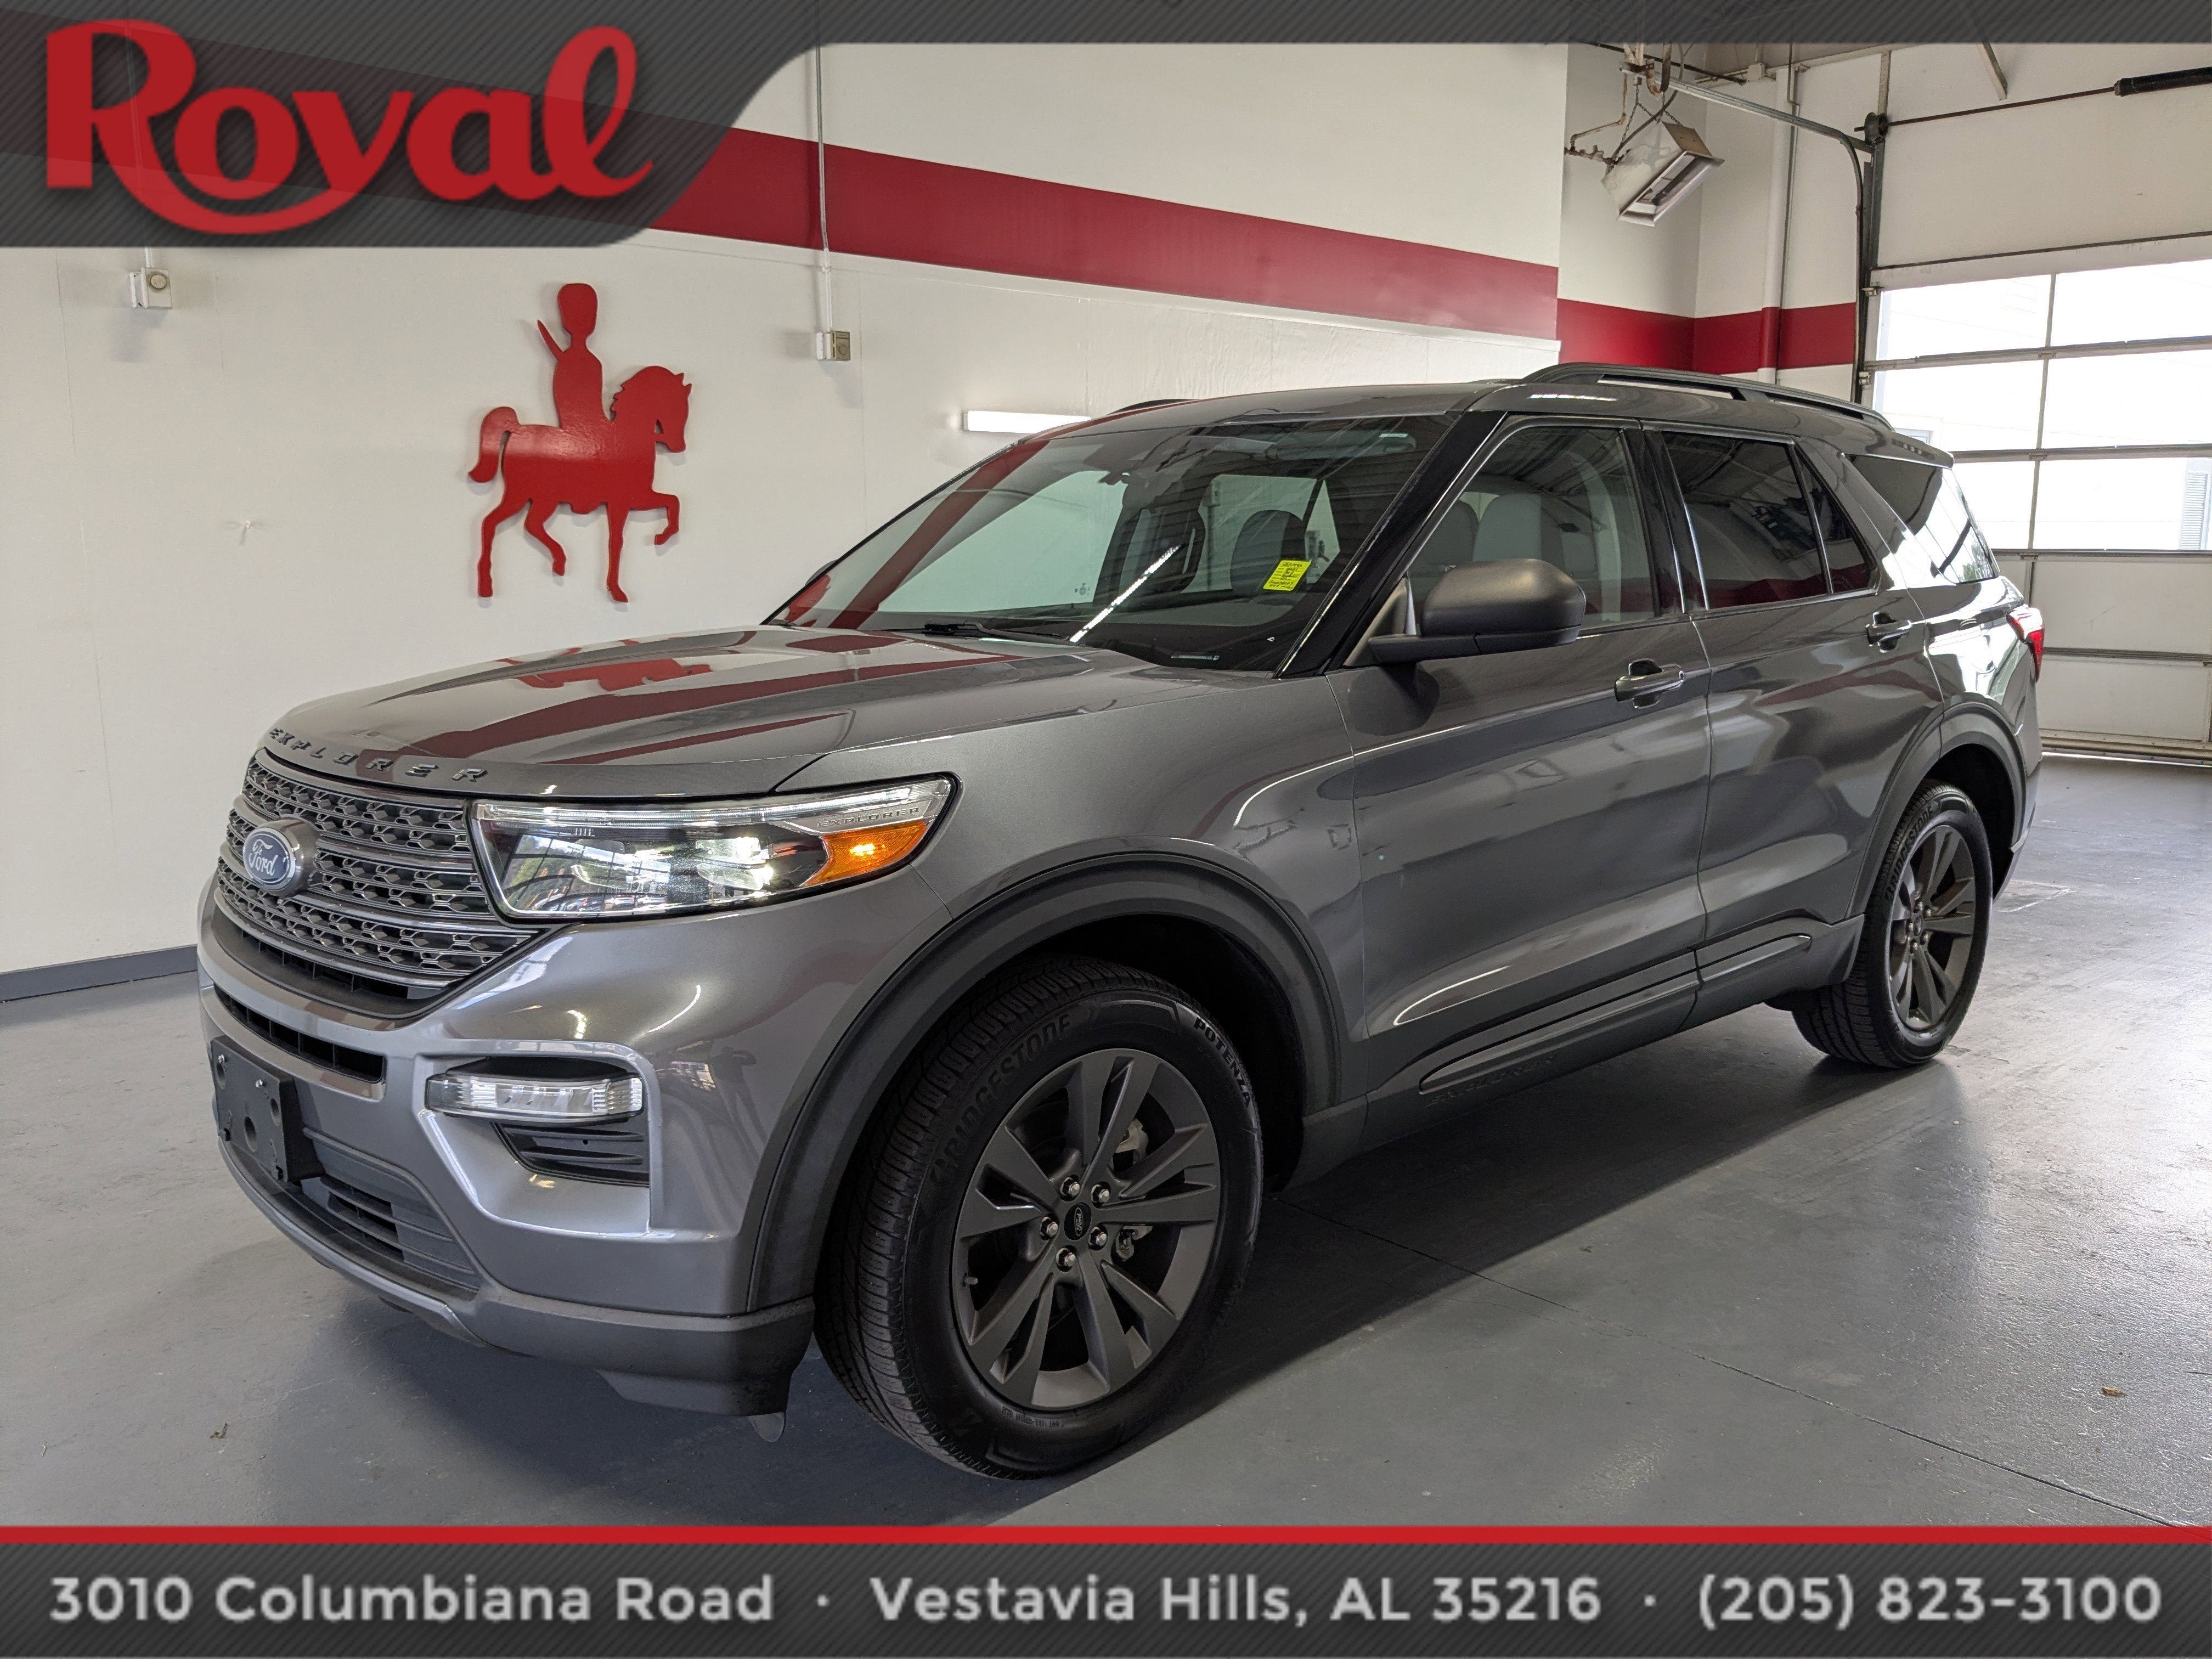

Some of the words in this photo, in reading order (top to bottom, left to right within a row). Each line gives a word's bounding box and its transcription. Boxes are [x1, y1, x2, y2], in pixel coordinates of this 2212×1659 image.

[269, 727, 488, 782] EXPLORER
[817, 807, 920, 828] EXPLORER
[249, 839, 276, 877] Ford
[1193, 1017, 1251, 1108] POTENZA
